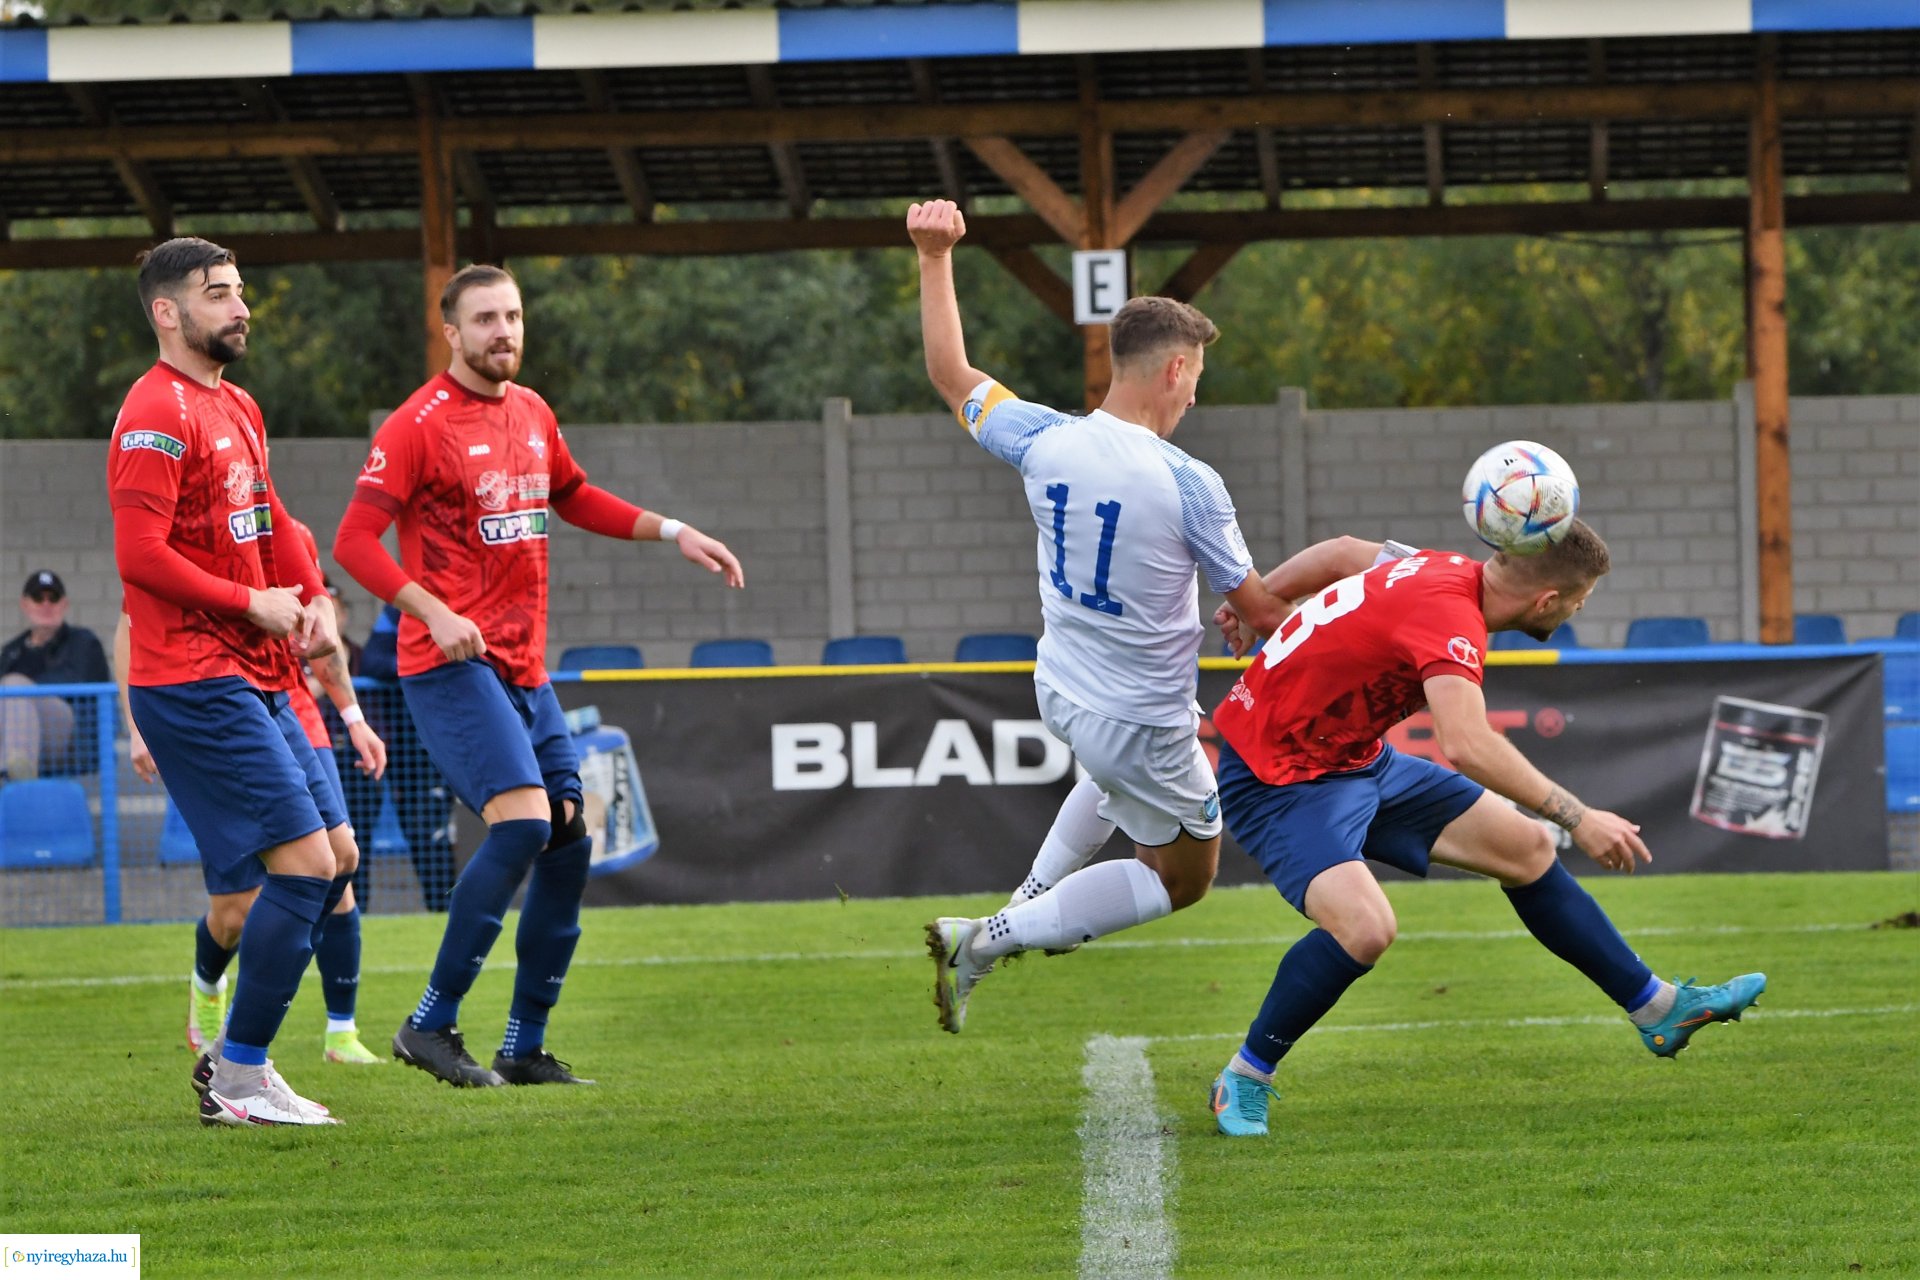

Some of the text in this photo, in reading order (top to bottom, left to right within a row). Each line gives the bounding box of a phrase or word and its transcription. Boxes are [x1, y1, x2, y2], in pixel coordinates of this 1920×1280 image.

[1087, 259, 1112, 315] E
[1046, 483, 1123, 616] 11
[1261, 570, 1366, 670] 8
[771, 718, 1087, 791] BLAD
